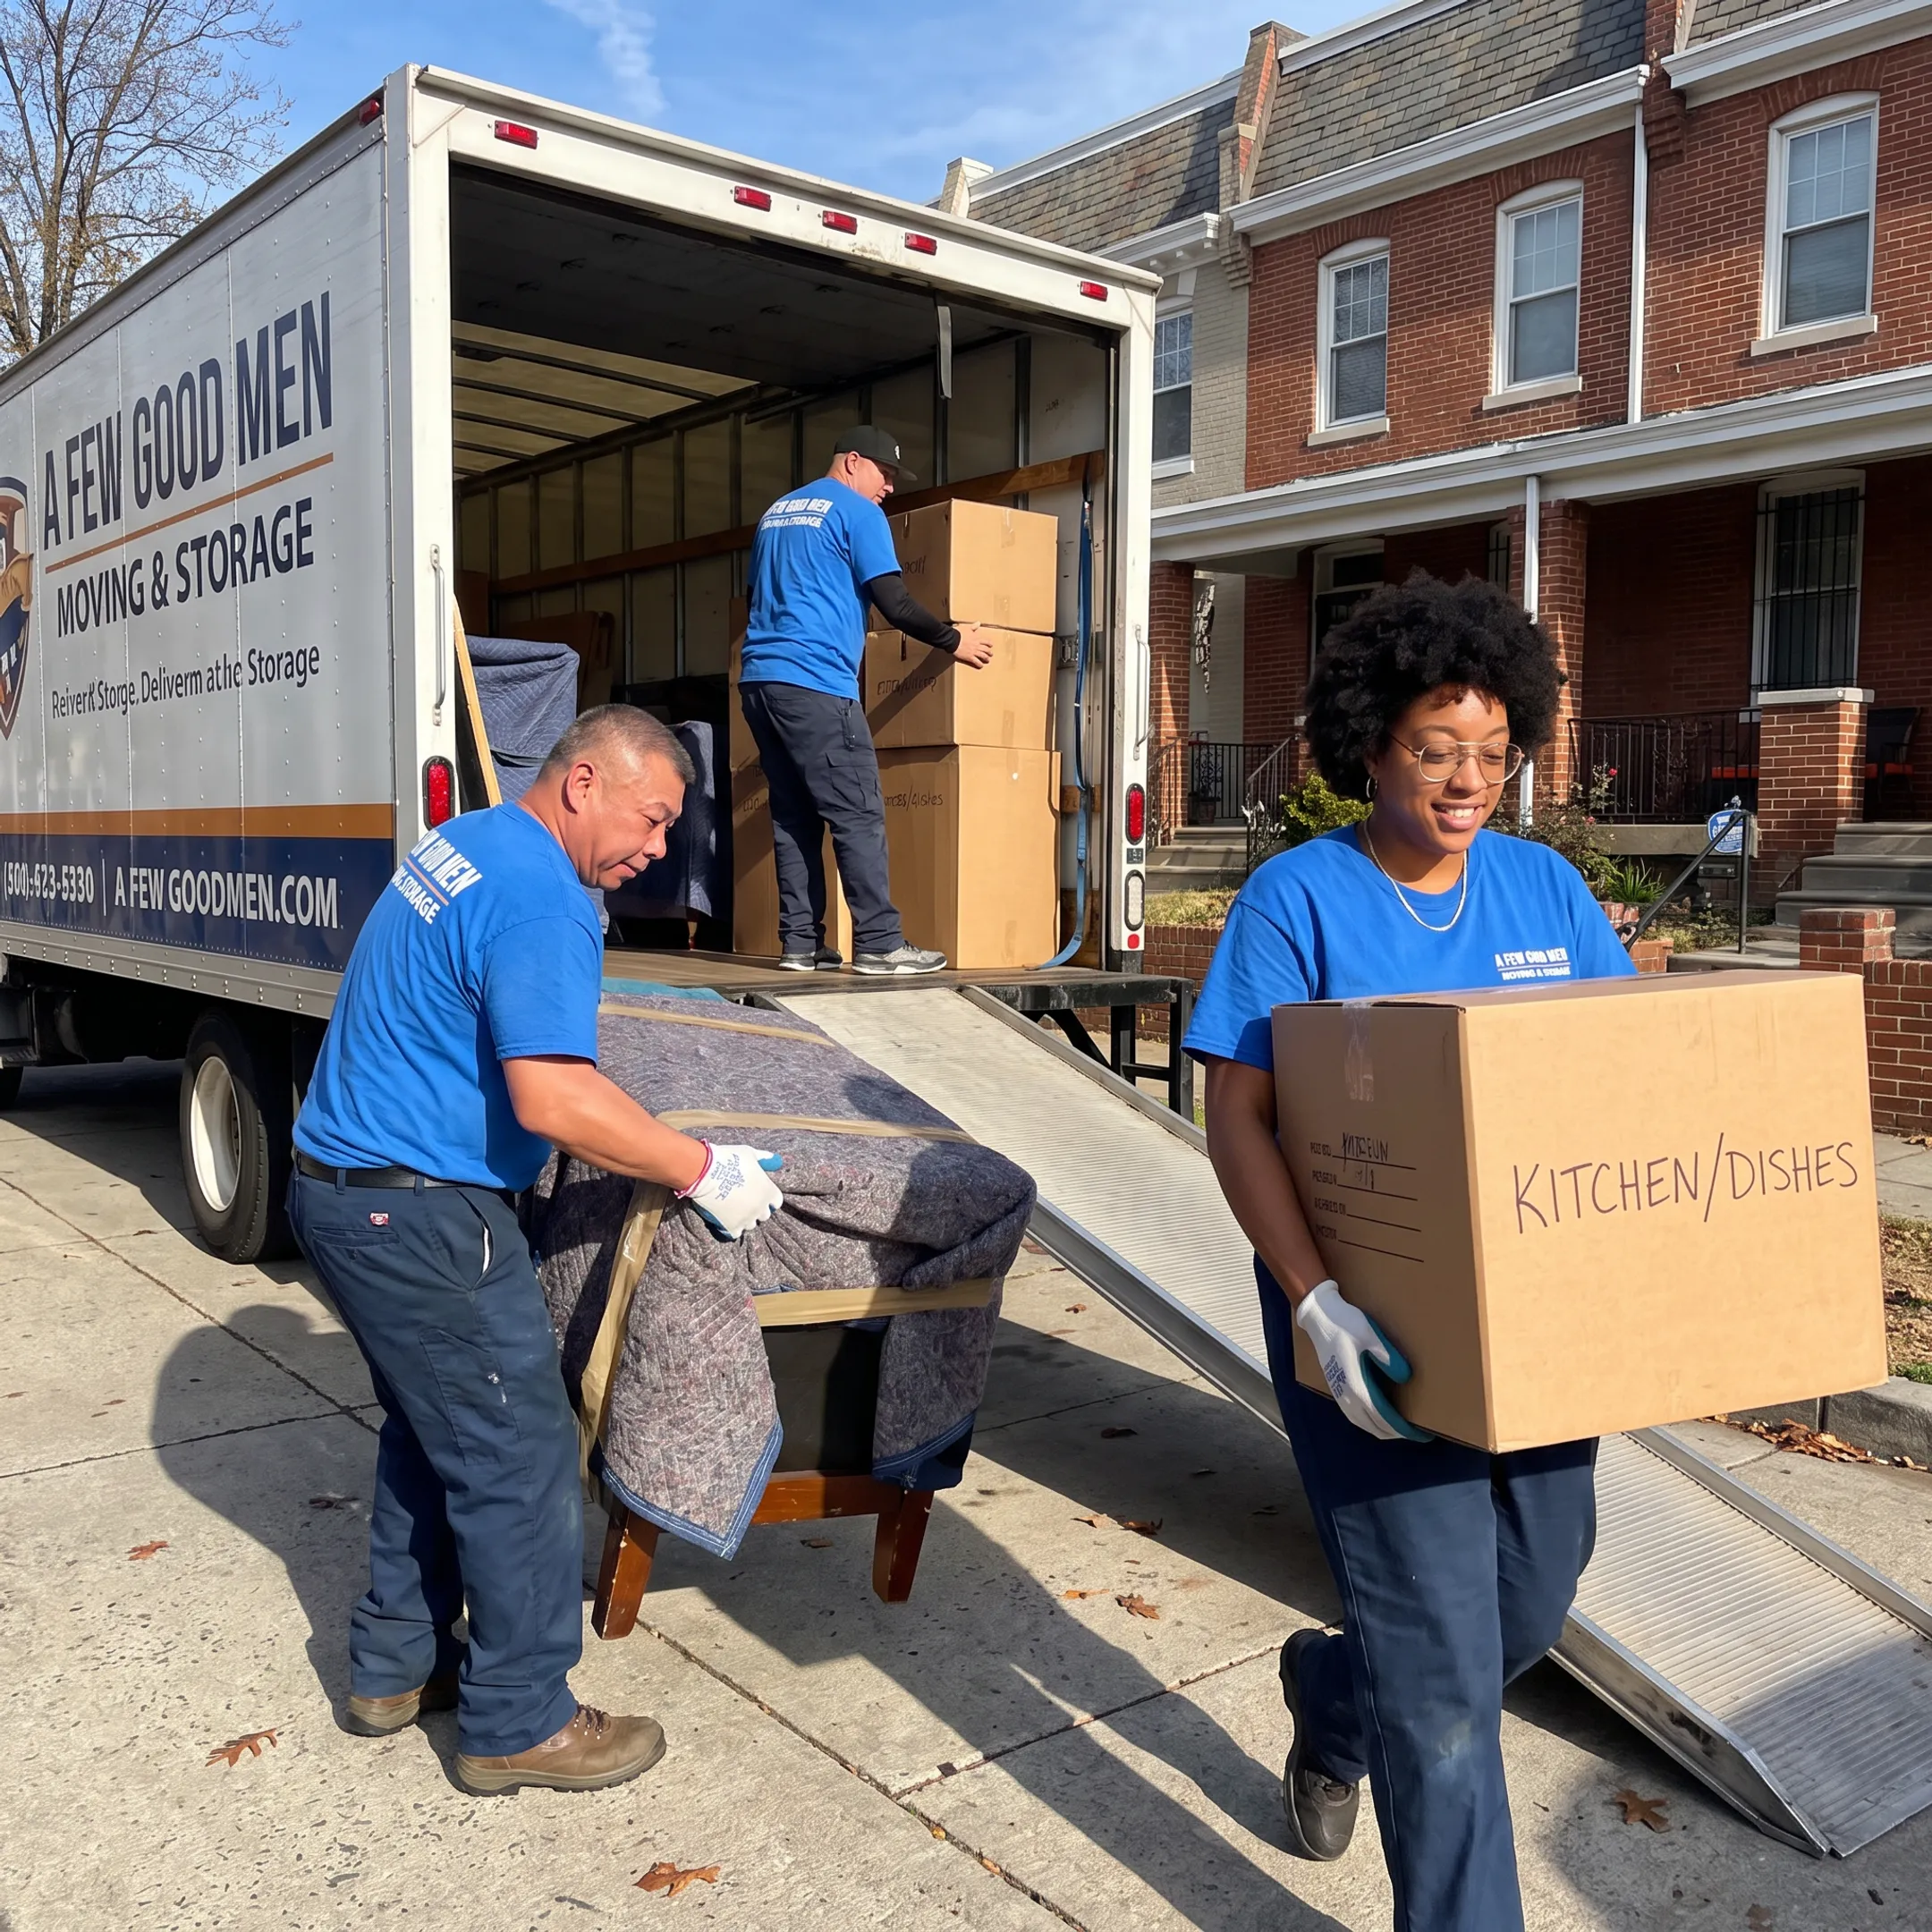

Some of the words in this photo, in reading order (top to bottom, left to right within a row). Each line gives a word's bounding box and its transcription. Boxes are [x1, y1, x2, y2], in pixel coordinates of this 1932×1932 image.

[44, 450, 62, 551] A
[65, 411, 123, 541] FEW
[132, 357, 225, 510] GOOD
[235, 290, 333, 467] MEN
[57, 558, 145, 638] MOVING
[150, 550, 170, 611] &
[176, 496, 315, 604] STORAGE
[247, 645, 320, 689] Storage
[114, 866, 127, 907] A
[129, 867, 165, 911] FEW
[167, 869, 338, 929] GOODMEN.COM
[431, 852, 484, 899] MEN
[1513, 1131, 1859, 1235] KITCHEN/DISHES
